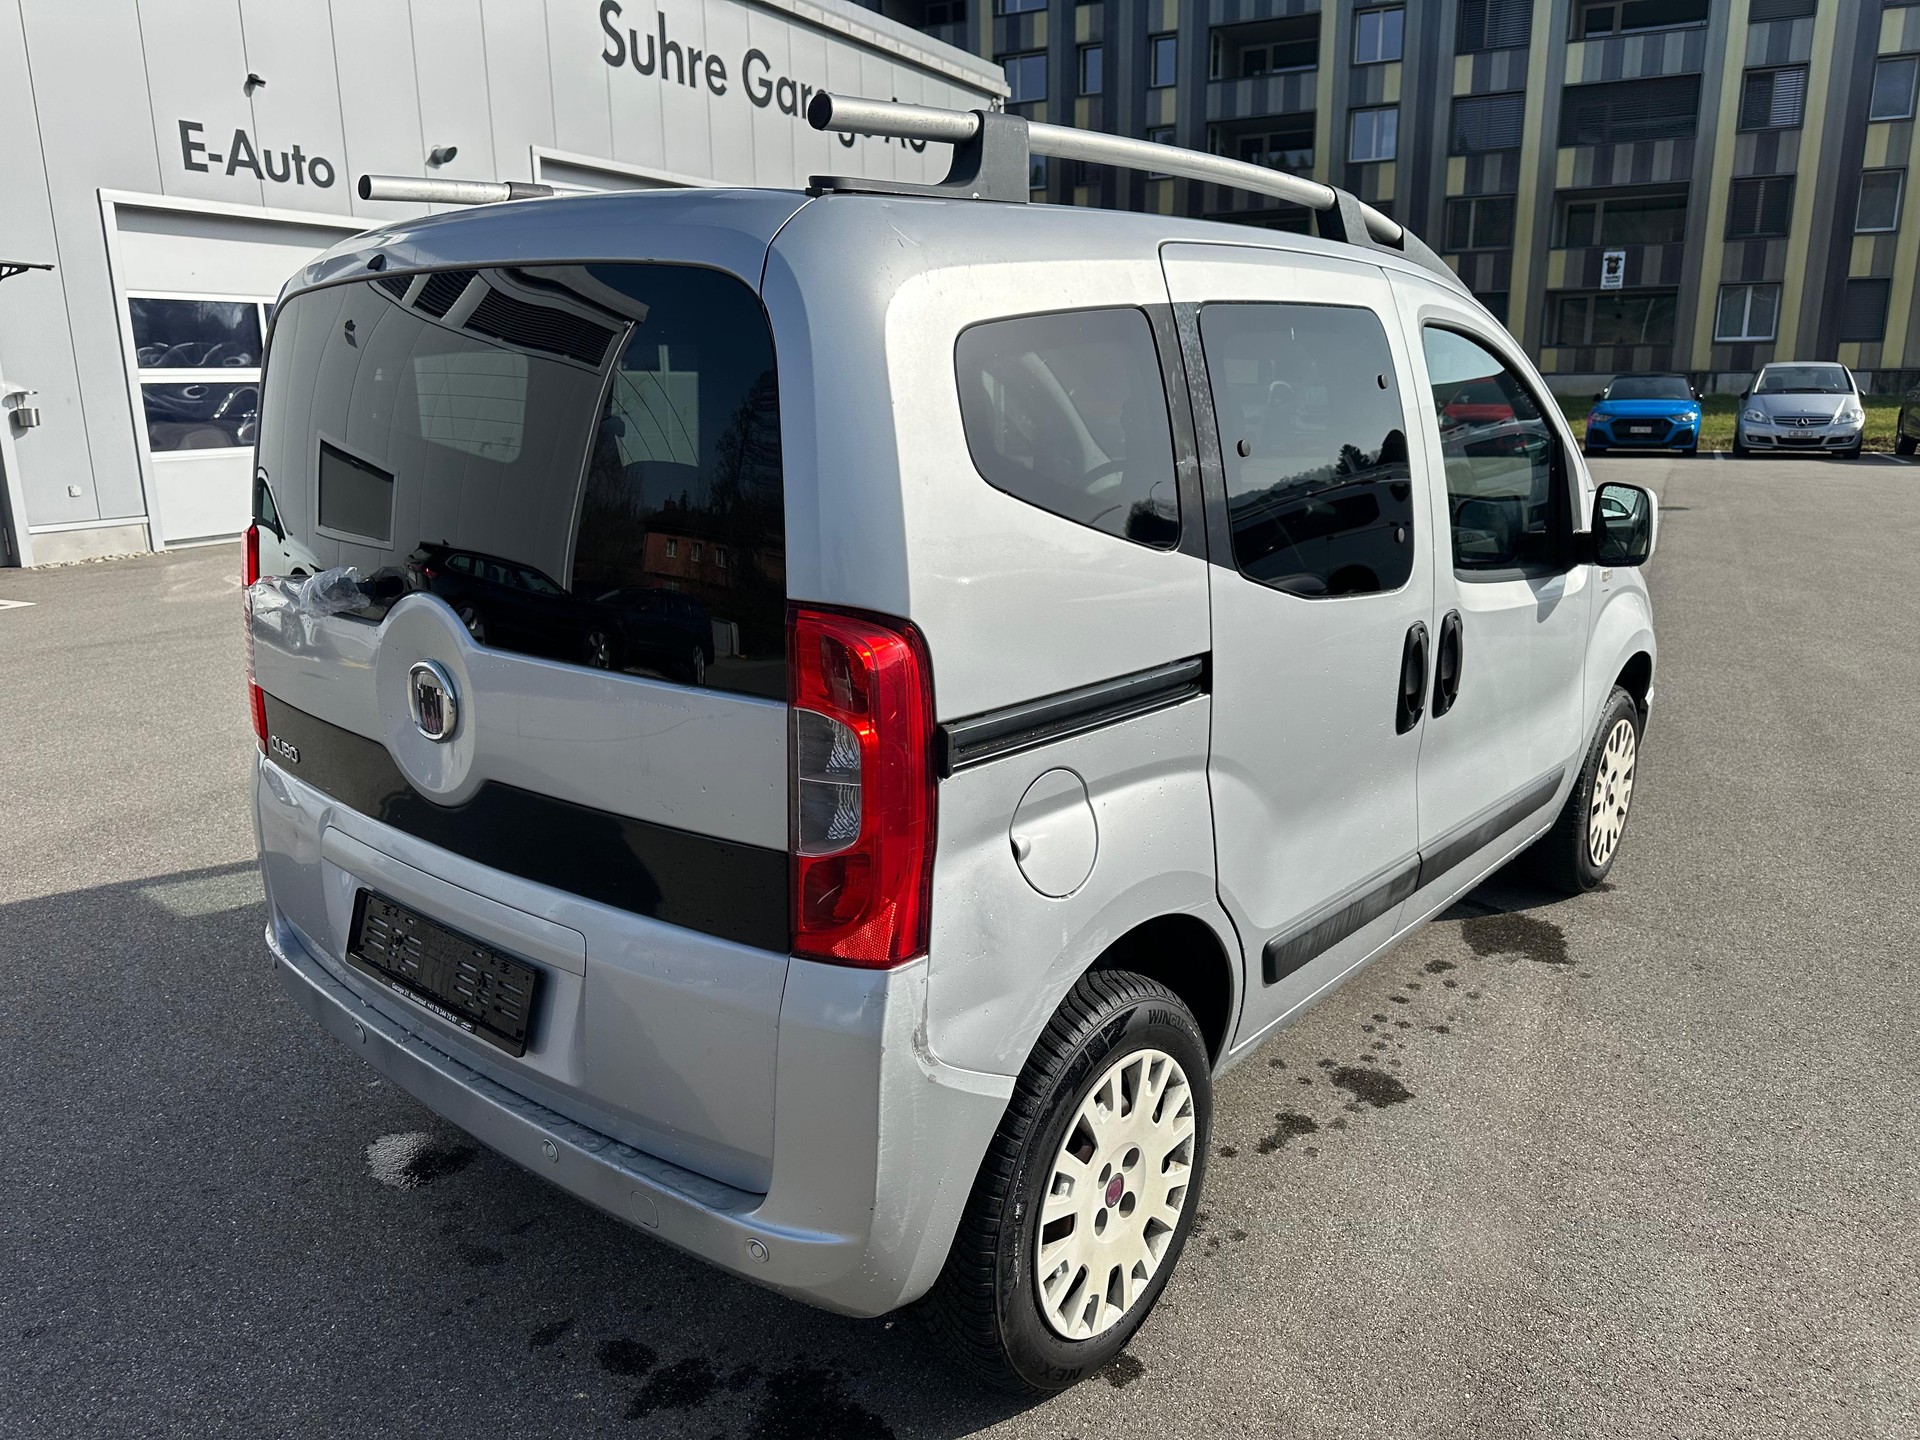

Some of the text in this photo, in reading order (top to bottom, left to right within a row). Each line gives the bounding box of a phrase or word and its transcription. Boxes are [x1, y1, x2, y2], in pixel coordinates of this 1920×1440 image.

[599, 1, 727, 97] Suhre
[742, 48, 873, 148] Gar
[178, 119, 335, 188] E-Auto
